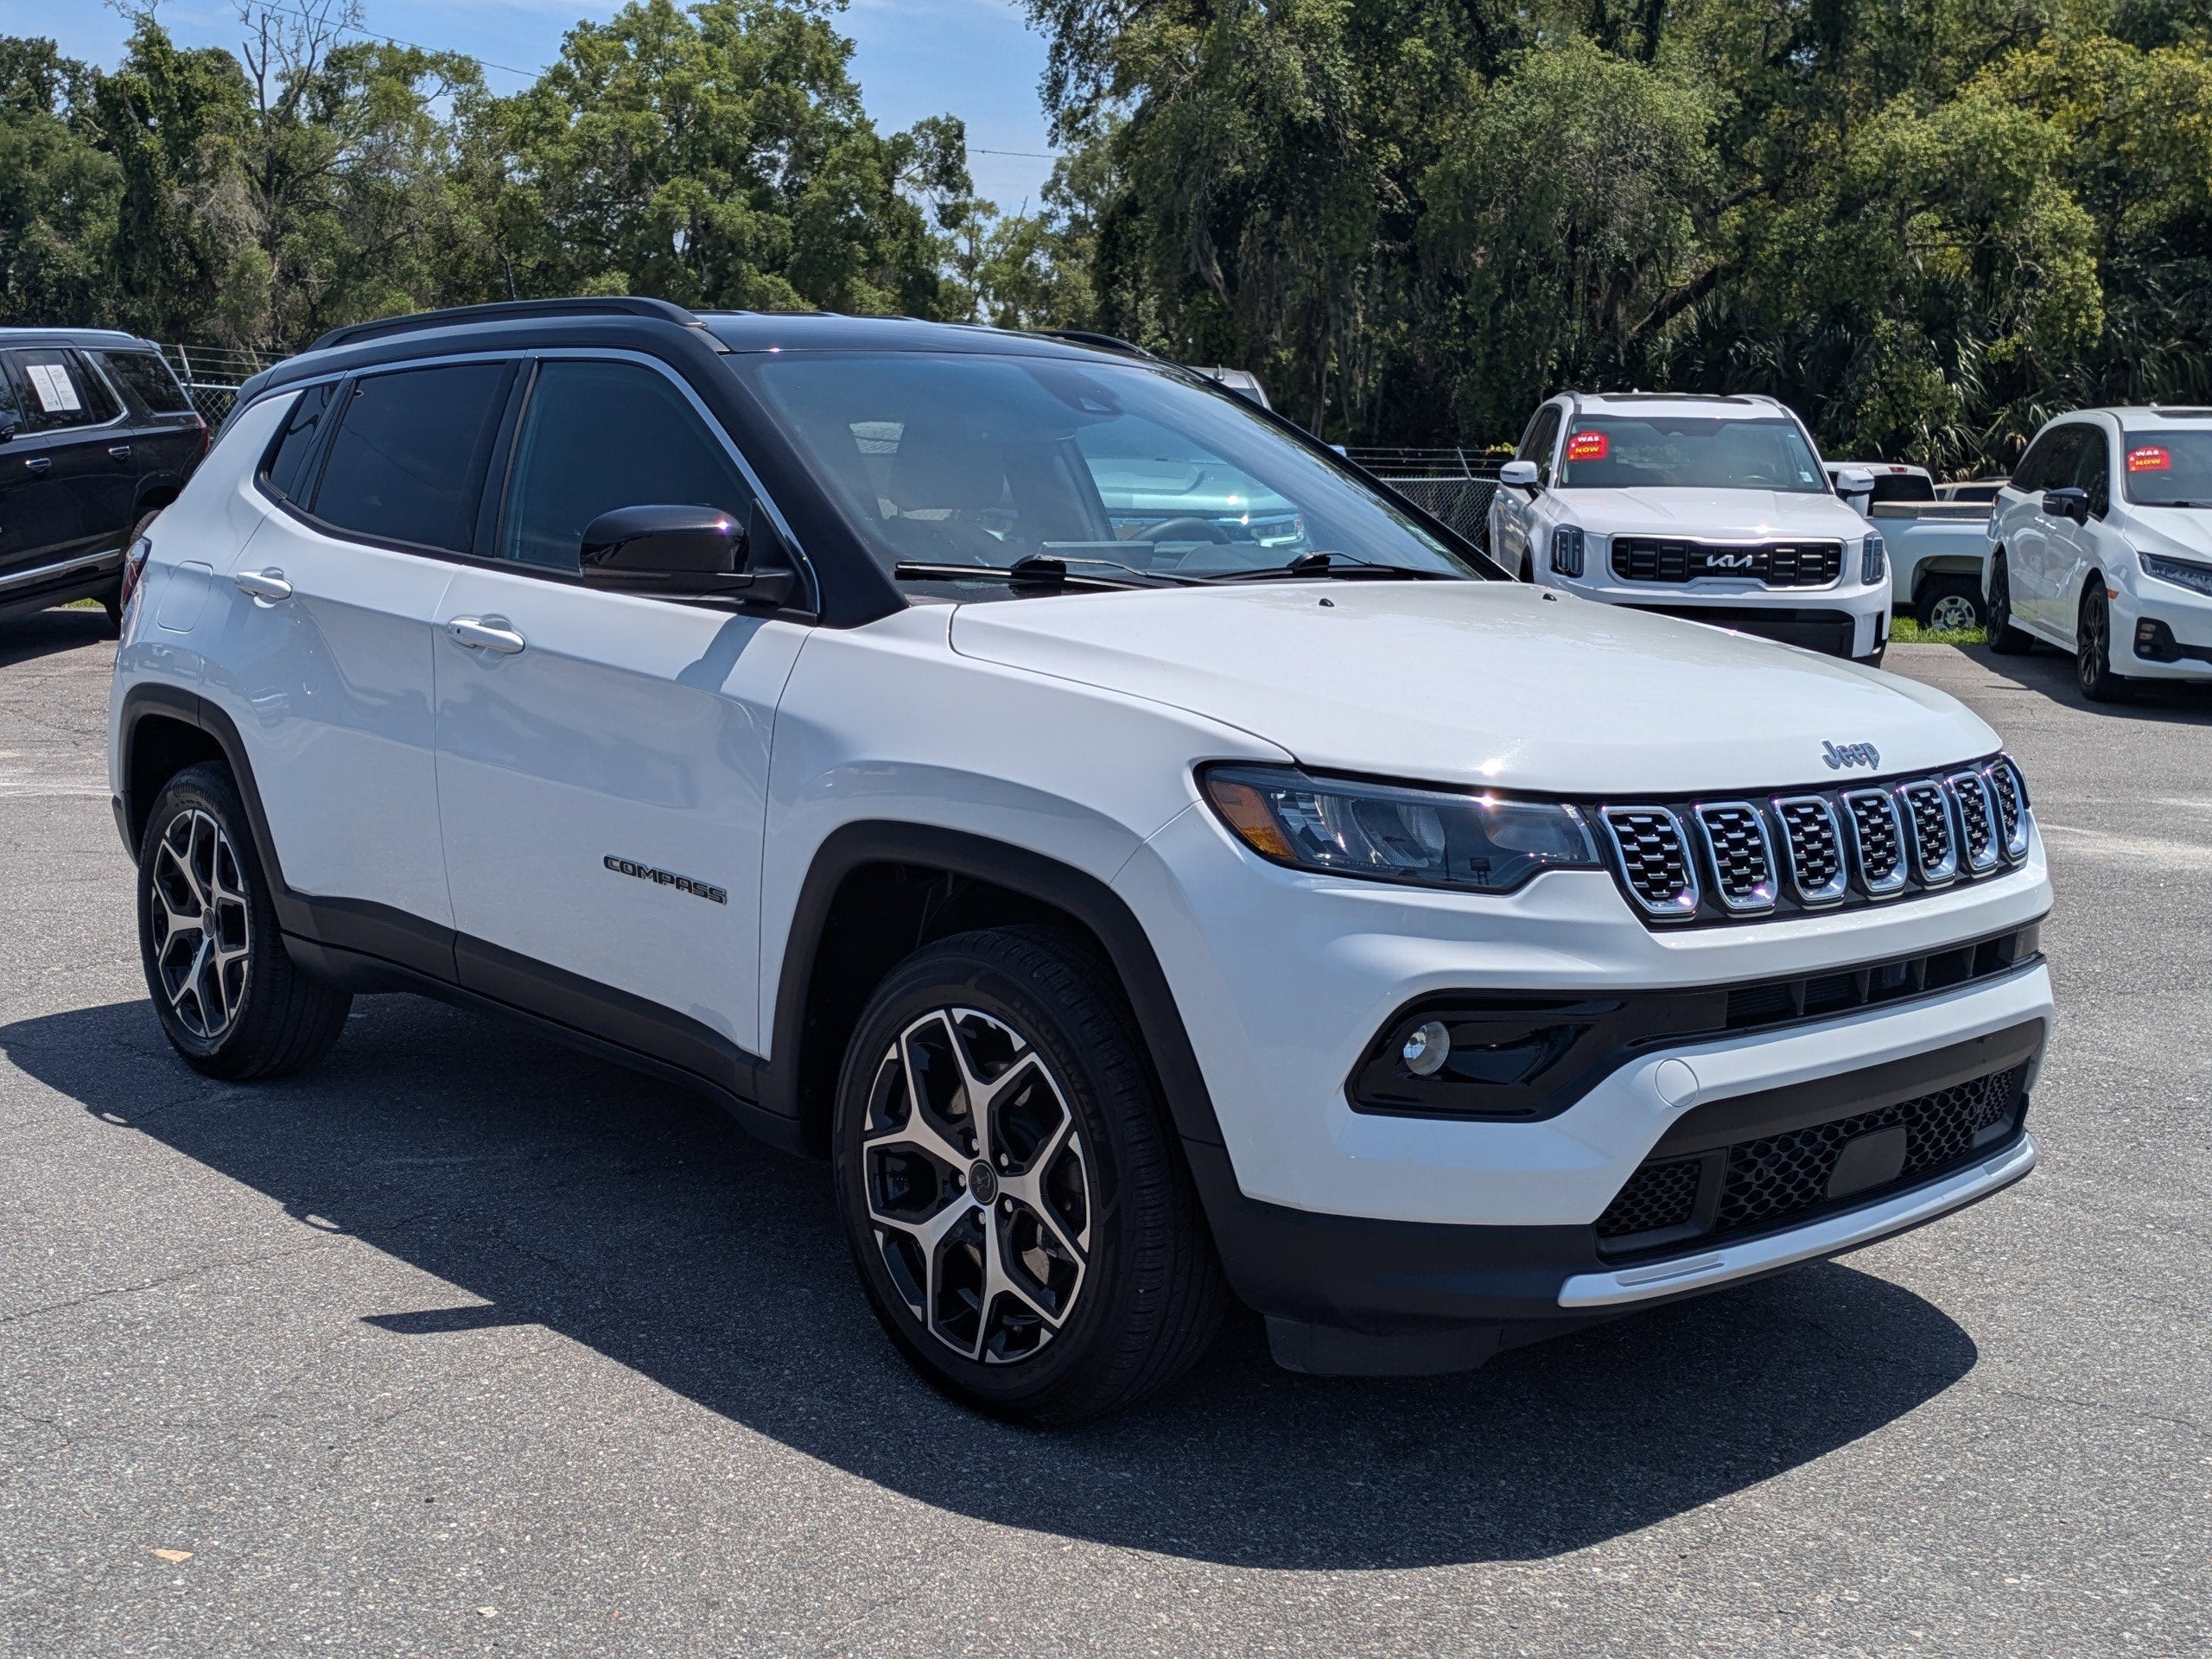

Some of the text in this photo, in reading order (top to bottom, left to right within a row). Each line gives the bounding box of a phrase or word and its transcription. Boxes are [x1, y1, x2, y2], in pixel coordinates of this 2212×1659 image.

[1707, 554, 1753, 568] KIA
[1821, 740, 1880, 771] Jeep
[603, 854, 728, 905] COMPASS
